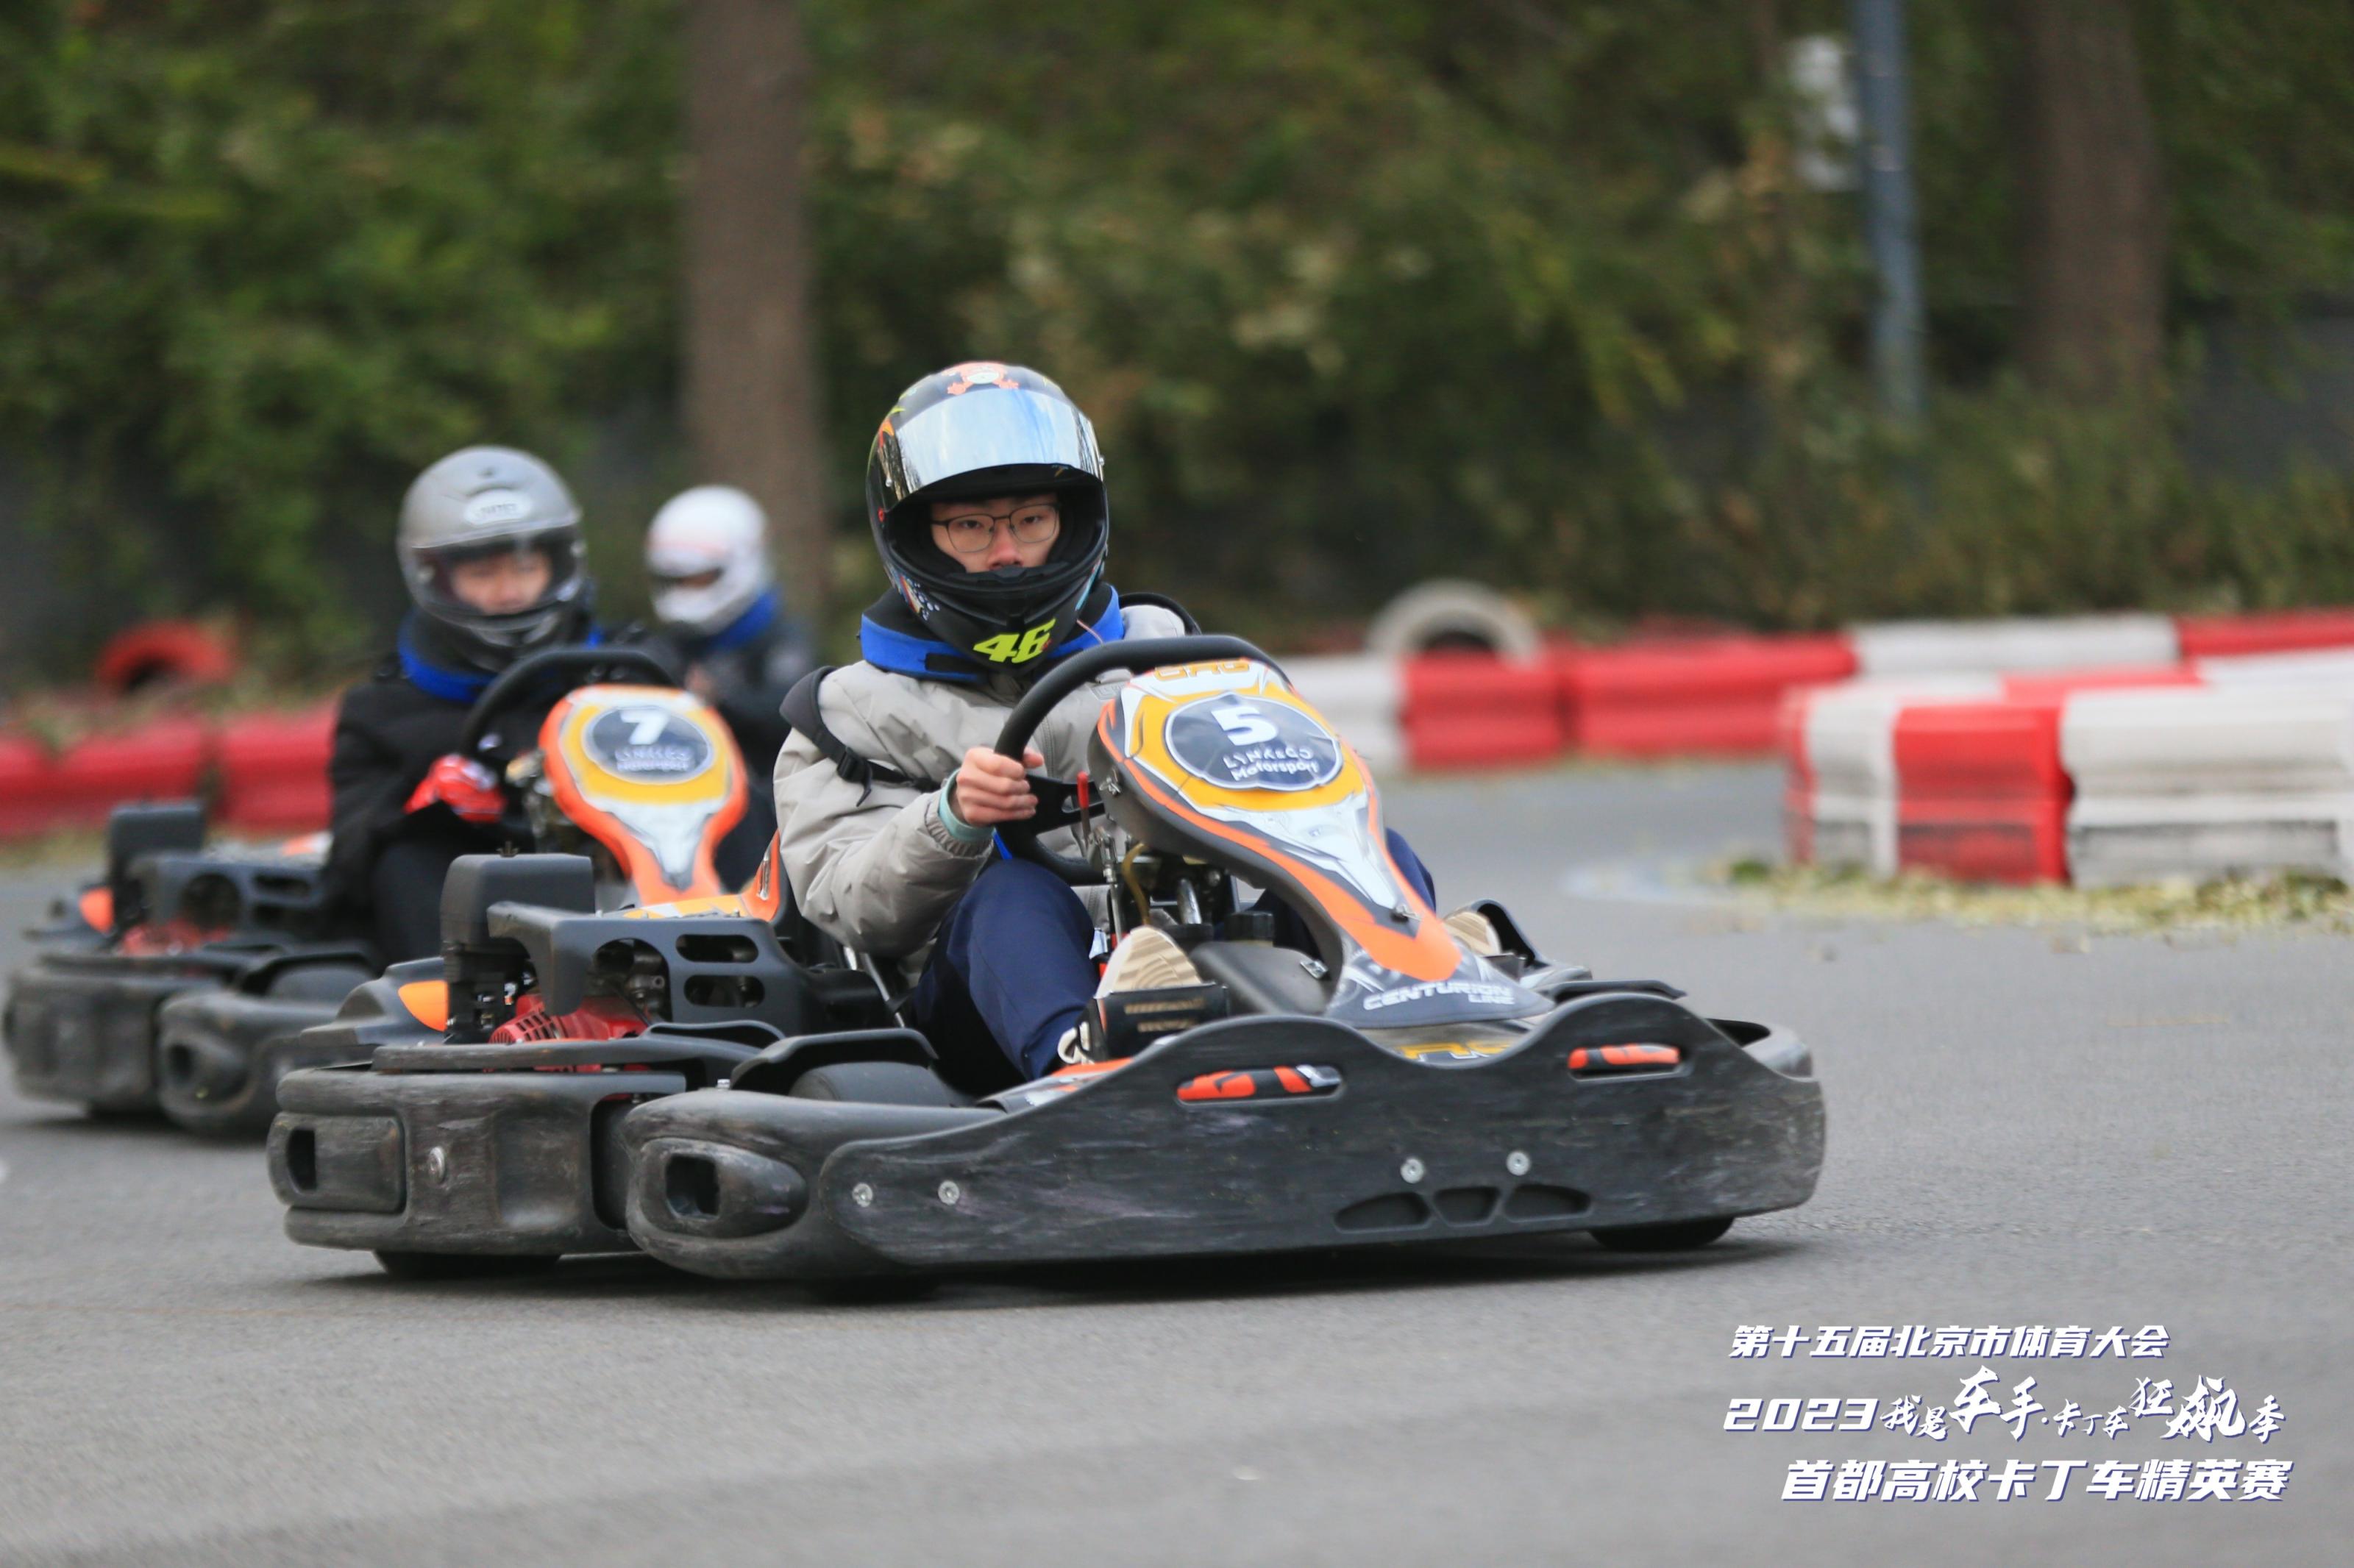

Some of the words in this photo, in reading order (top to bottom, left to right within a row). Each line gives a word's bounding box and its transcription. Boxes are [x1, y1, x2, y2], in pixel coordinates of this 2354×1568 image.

[973, 618, 1056, 664] 46
[619, 709, 672, 745] 7
[1211, 706, 1277, 746] 5
[1231, 760, 1319, 781] Motorsport
[1363, 981, 1513, 1011] CENTURION
